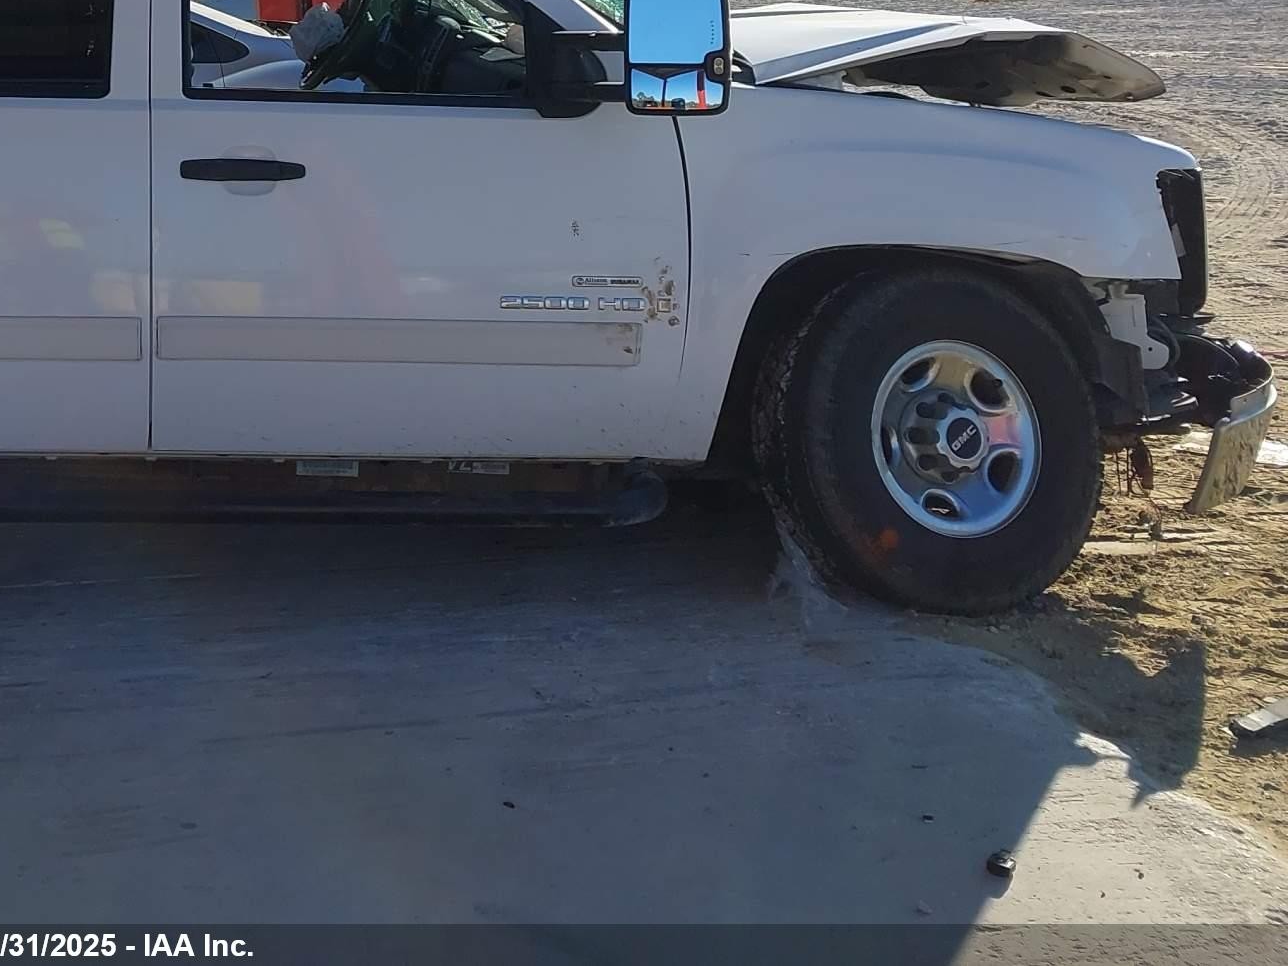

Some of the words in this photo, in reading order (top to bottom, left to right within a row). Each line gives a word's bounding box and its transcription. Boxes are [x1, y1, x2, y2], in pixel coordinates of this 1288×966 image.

[500, 296, 590, 310] 2500
[598, 297, 648, 311] HD
[951, 424, 977, 452] GMC
